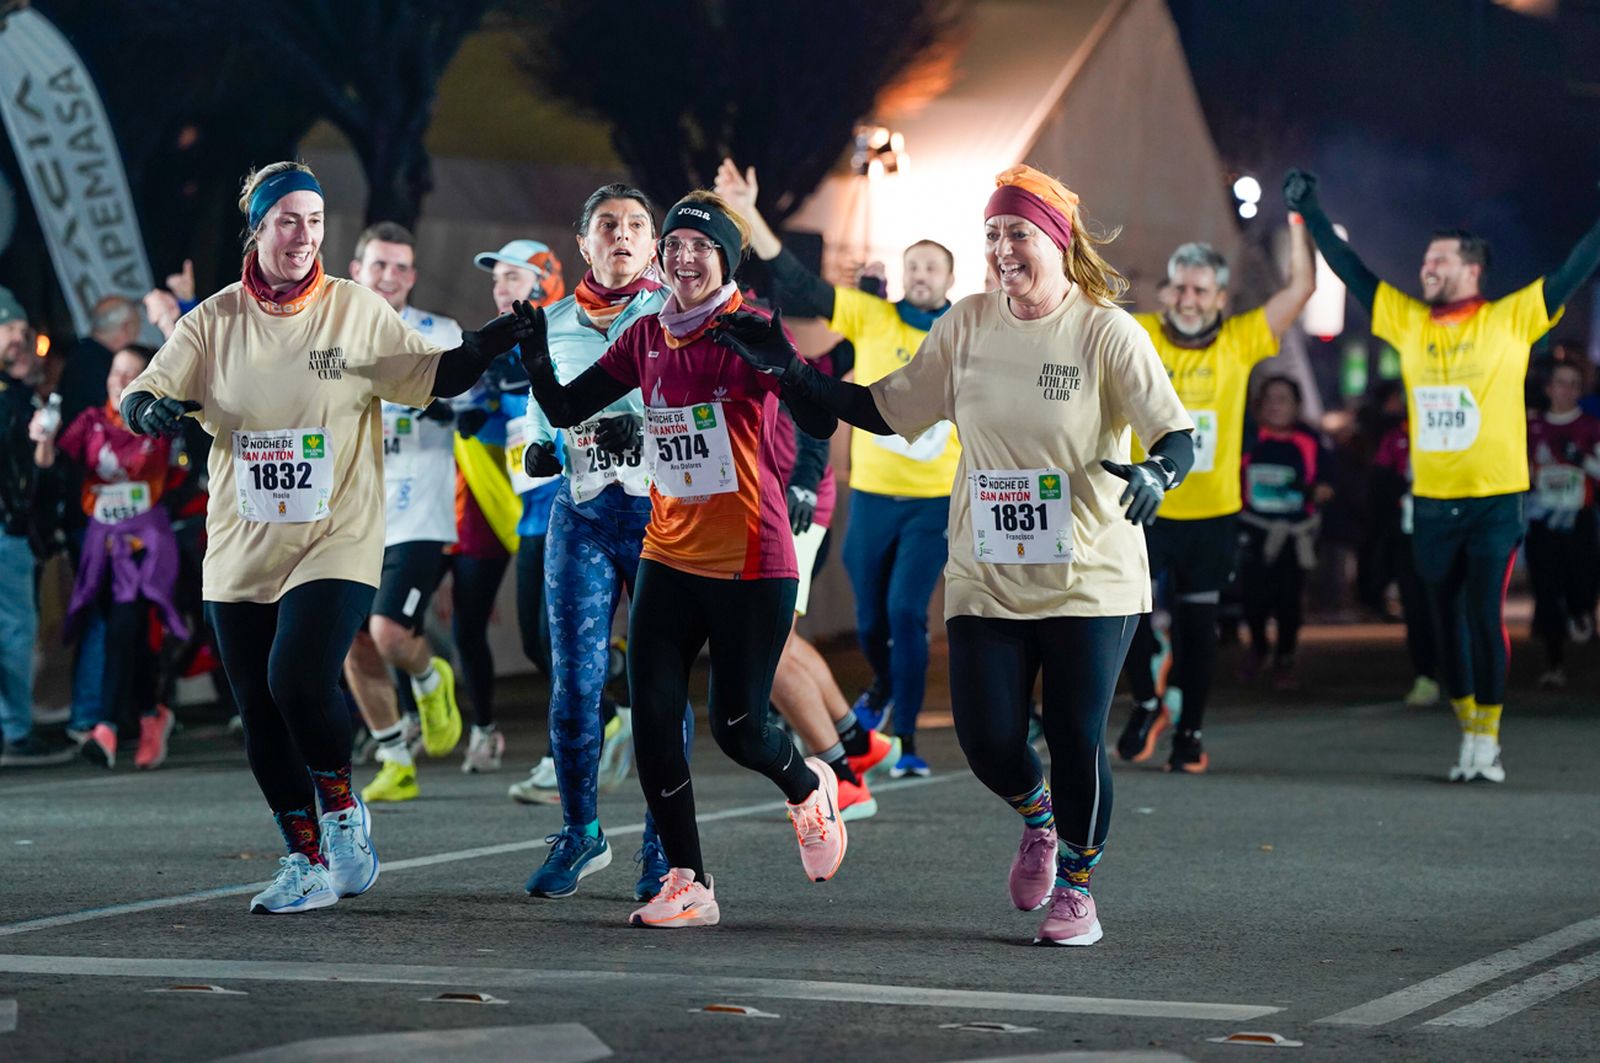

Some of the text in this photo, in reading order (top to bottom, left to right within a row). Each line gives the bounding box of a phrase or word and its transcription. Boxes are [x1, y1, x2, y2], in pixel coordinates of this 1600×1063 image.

[47, 65, 146, 292] APEMASA
[309, 346, 343, 360] HYBRID
[308, 358, 348, 371] ATHLETE
[1041, 362, 1080, 378] HYBRID
[317, 369, 342, 381] CLUB
[1036, 375, 1082, 391] ATHLETE
[1043, 388, 1071, 402] CLUB
[674, 412, 685, 423] DE
[1427, 410, 1466, 429] 5739
[660, 422, 689, 435] ANTÓN
[250, 438, 294, 449] NOCHE DE
[655, 433, 710, 462] 5174
[242, 450, 259, 462] SAN
[260, 448, 294, 462] ANTÓN
[249, 462, 313, 491] 1832
[988, 479, 1030, 490] NOCHE DE
[979, 490, 997, 501] SAN
[997, 489, 1031, 502] ANTÓN
[990, 503, 1048, 532] 1831
